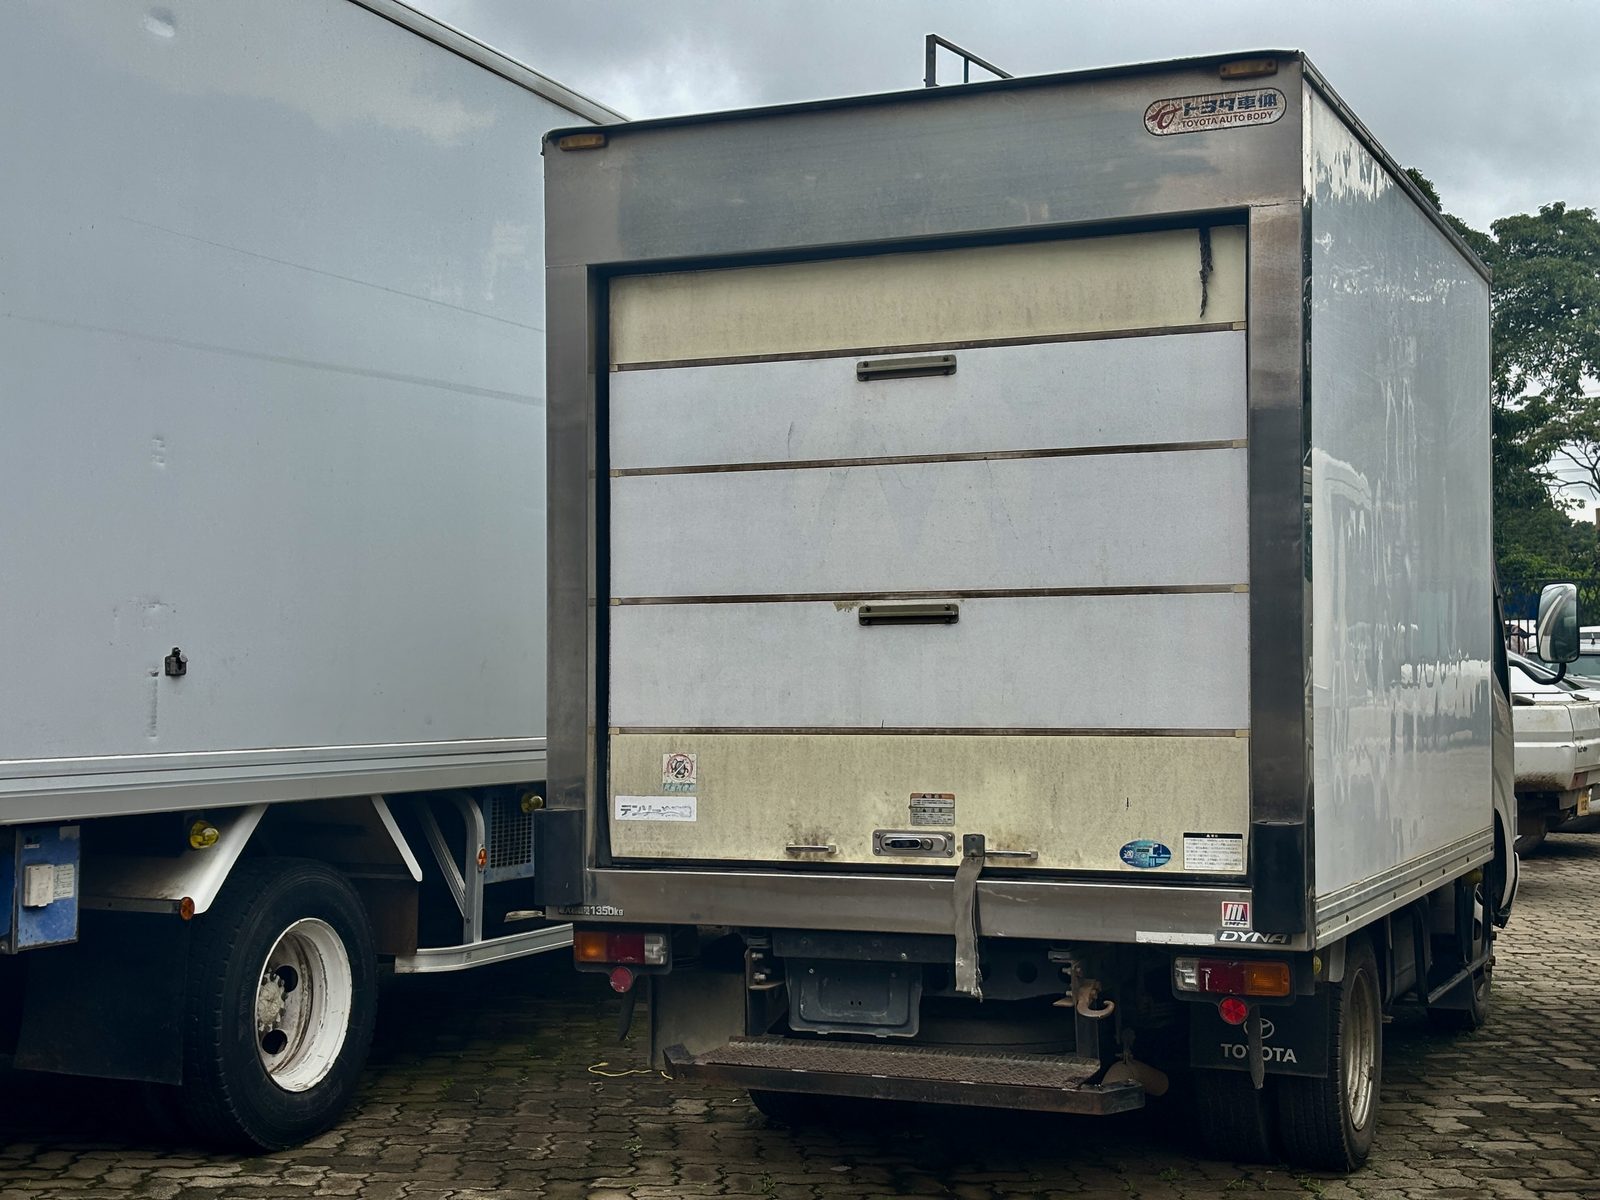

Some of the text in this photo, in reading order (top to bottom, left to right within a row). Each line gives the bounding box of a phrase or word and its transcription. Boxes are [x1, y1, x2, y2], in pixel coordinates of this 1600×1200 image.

[1182, 110, 1274, 128] TOYOTA AUTO BODY
[1219, 930, 1288, 944] DYNA
[1220, 1043, 1298, 1064] TOOTA
